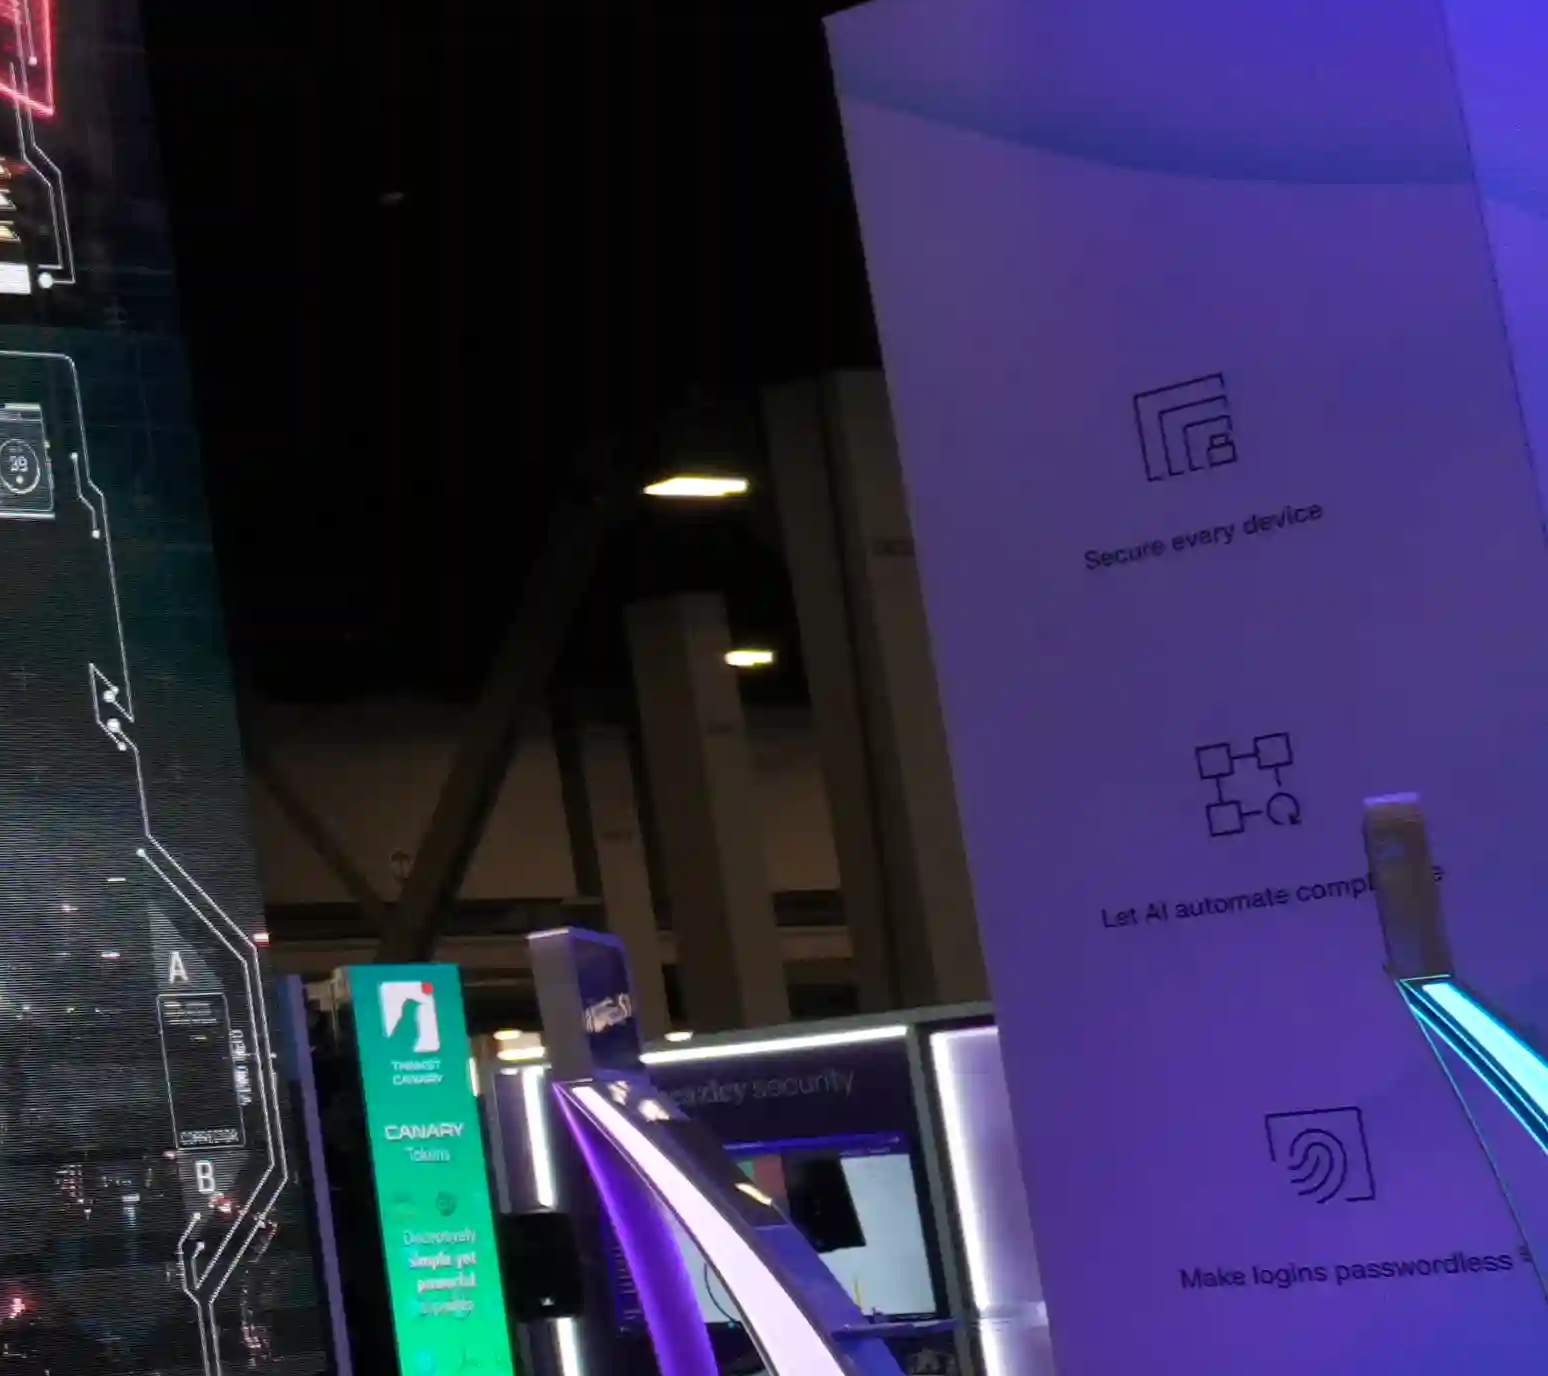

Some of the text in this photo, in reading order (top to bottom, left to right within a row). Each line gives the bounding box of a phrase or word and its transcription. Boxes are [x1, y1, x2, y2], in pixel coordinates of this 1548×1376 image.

[1084, 502, 1324, 571] Secure every device
[1102, 903, 1139, 928] Let
[1145, 902, 1168, 924] AI
[1174, 888, 1289, 919] automate
[168, 951, 188, 984] A
[753, 1068, 855, 1098] security
[384, 1121, 465, 1141] CANARY
[195, 1160, 217, 1193] B
[1180, 1250, 1514, 1290] Make logins passwordless
